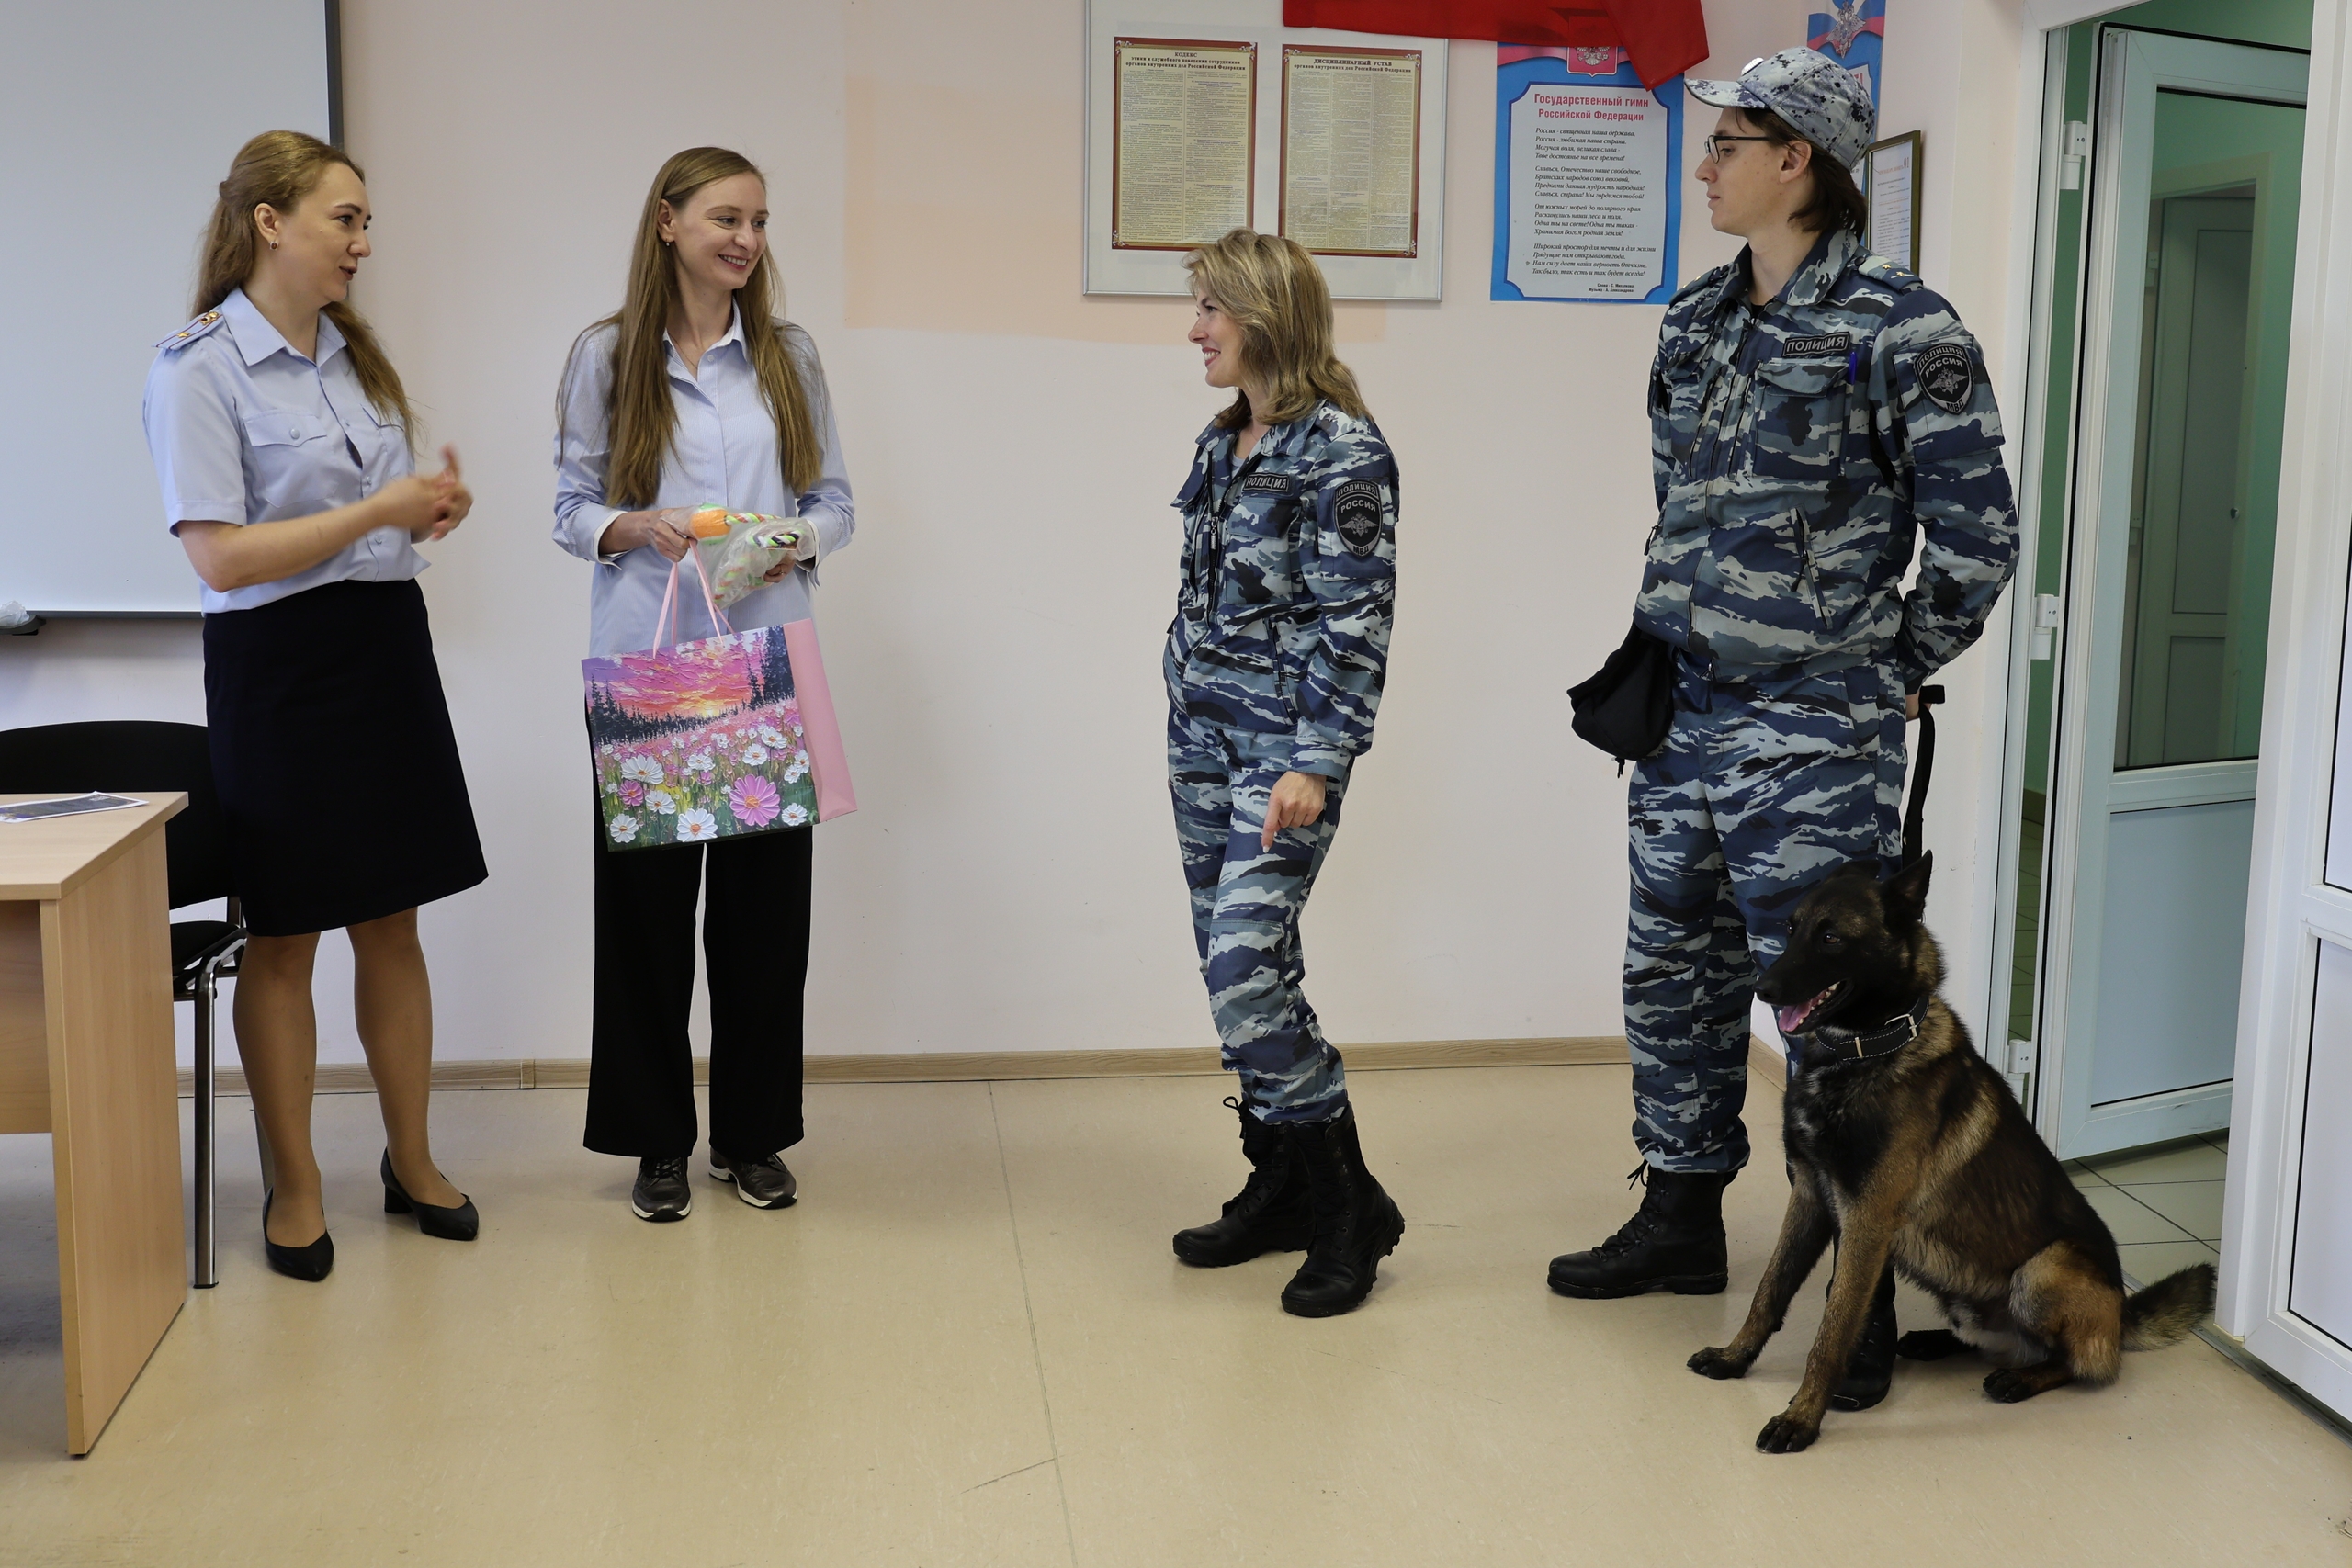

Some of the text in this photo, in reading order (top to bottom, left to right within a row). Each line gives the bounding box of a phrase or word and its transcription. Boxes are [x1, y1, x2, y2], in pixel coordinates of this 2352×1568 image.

[1534, 94, 1648, 107] Государственный гимн
[1539, 109, 1644, 121] Российской Федерации
[1786, 336, 1846, 352] ПОЛИЦИЯ
[1918, 346, 1963, 367] ПОЛИЦИЯ
[1926, 358, 1963, 378] РОССИЯ
[1946, 400, 1964, 412] МВД
[1246, 477, 1286, 488] ПОЛИЦИЯ
[1338, 483, 1376, 496] ПОЛИЦИЯ
[1340, 500, 1376, 513] РОССИЯ
[1353, 546, 1369, 556] МВД
